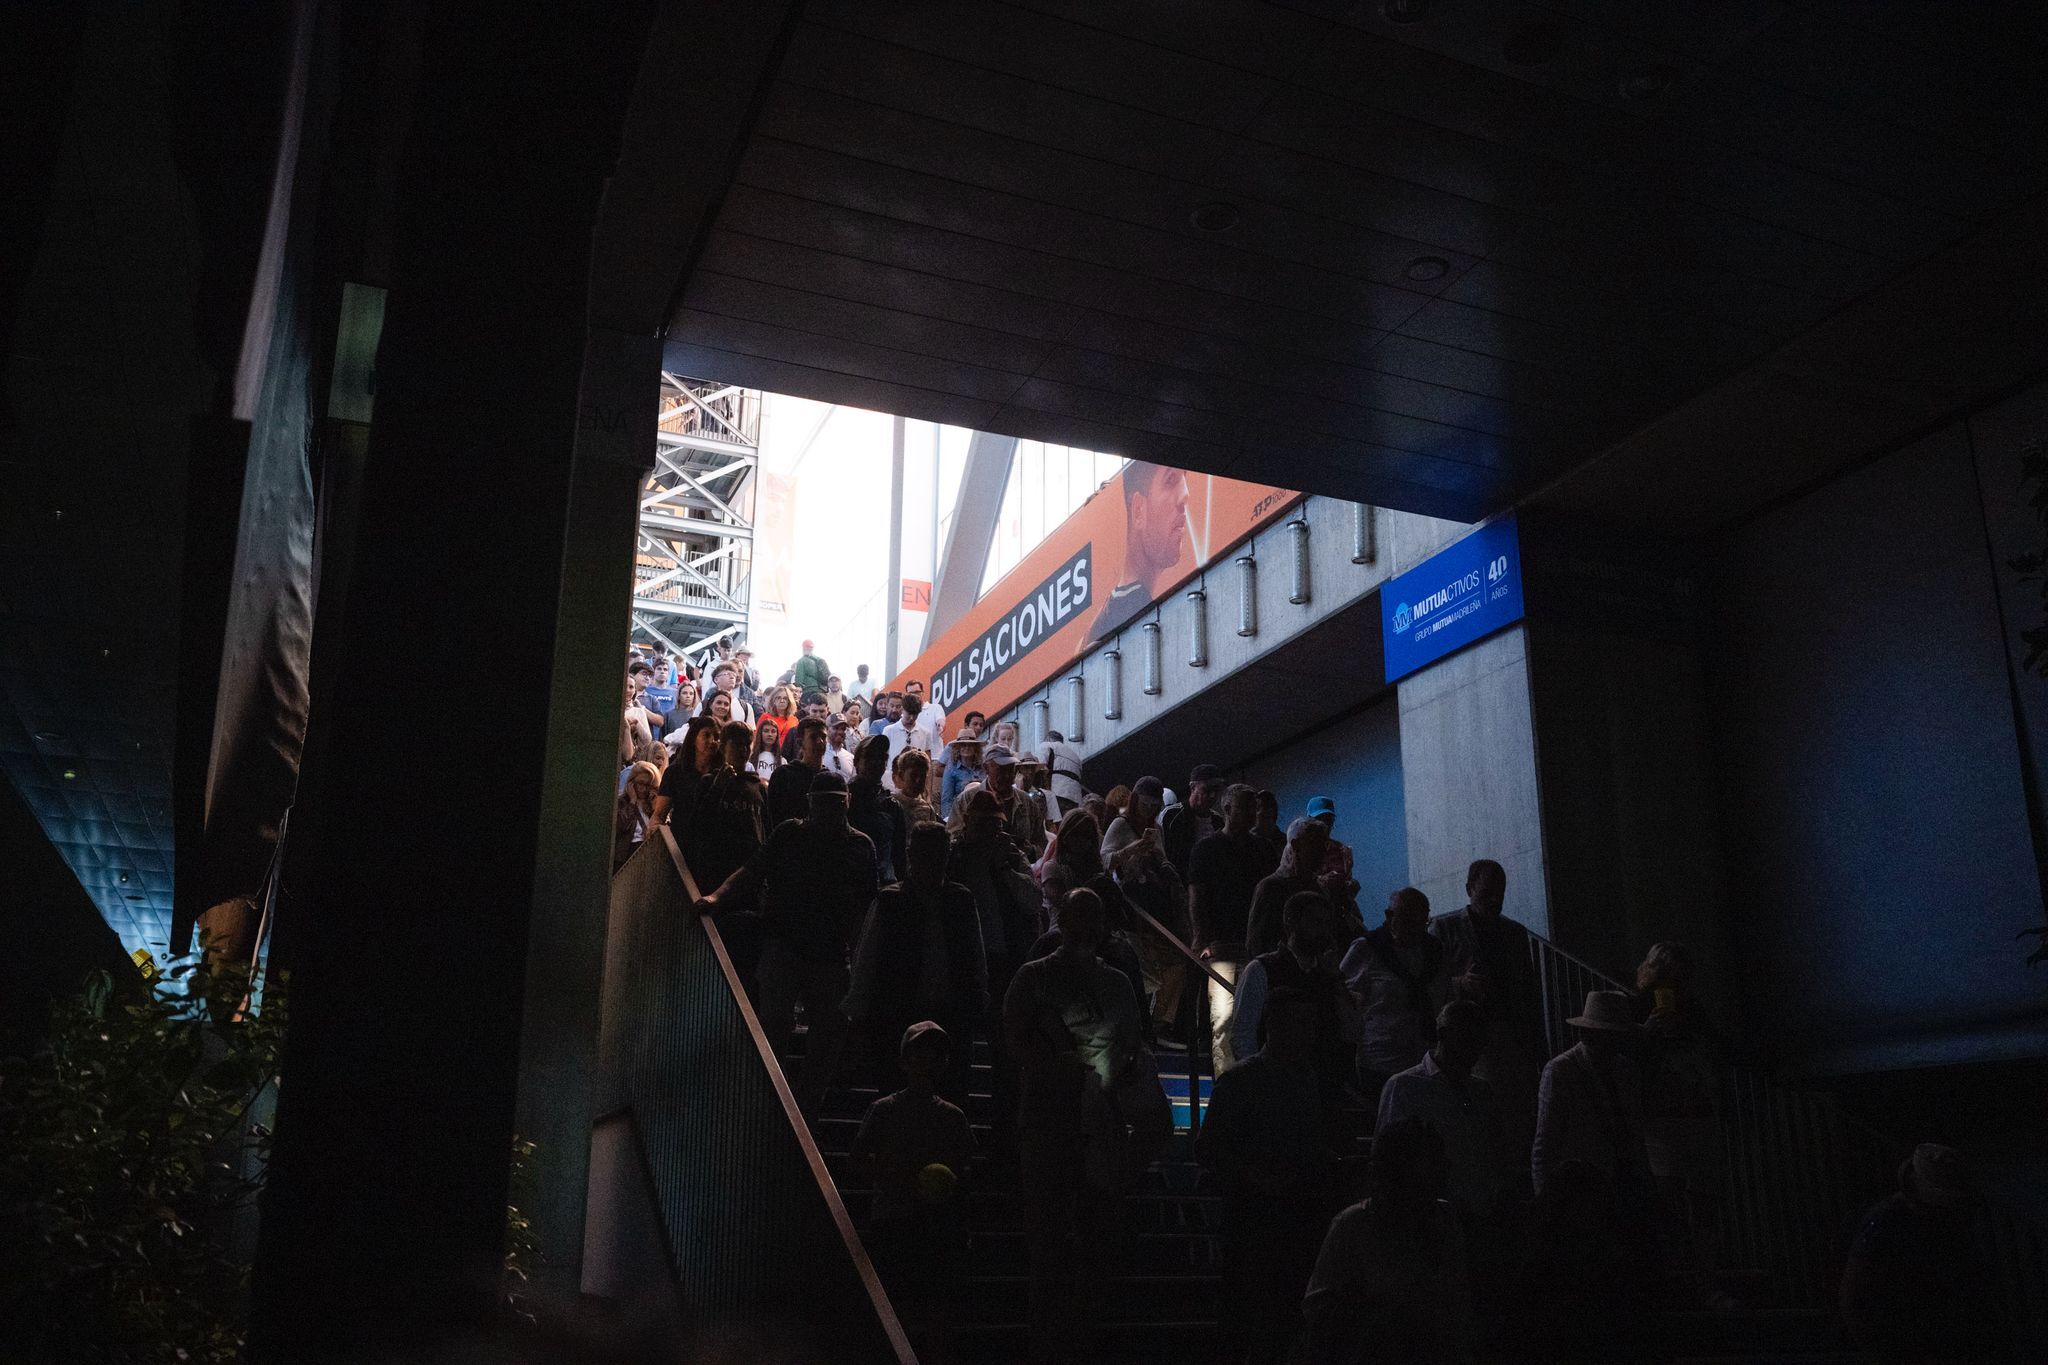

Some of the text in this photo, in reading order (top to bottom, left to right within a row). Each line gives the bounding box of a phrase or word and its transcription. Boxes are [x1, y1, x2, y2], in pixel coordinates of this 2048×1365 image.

[1413, 570, 1480, 621] MUTUACTIVOS
[1491, 584, 1508, 601] AÑOS
[932, 558, 1088, 708] PULSACIONES
[1415, 600, 1482, 642] GRUPO MUTUAMADRILEÑA
